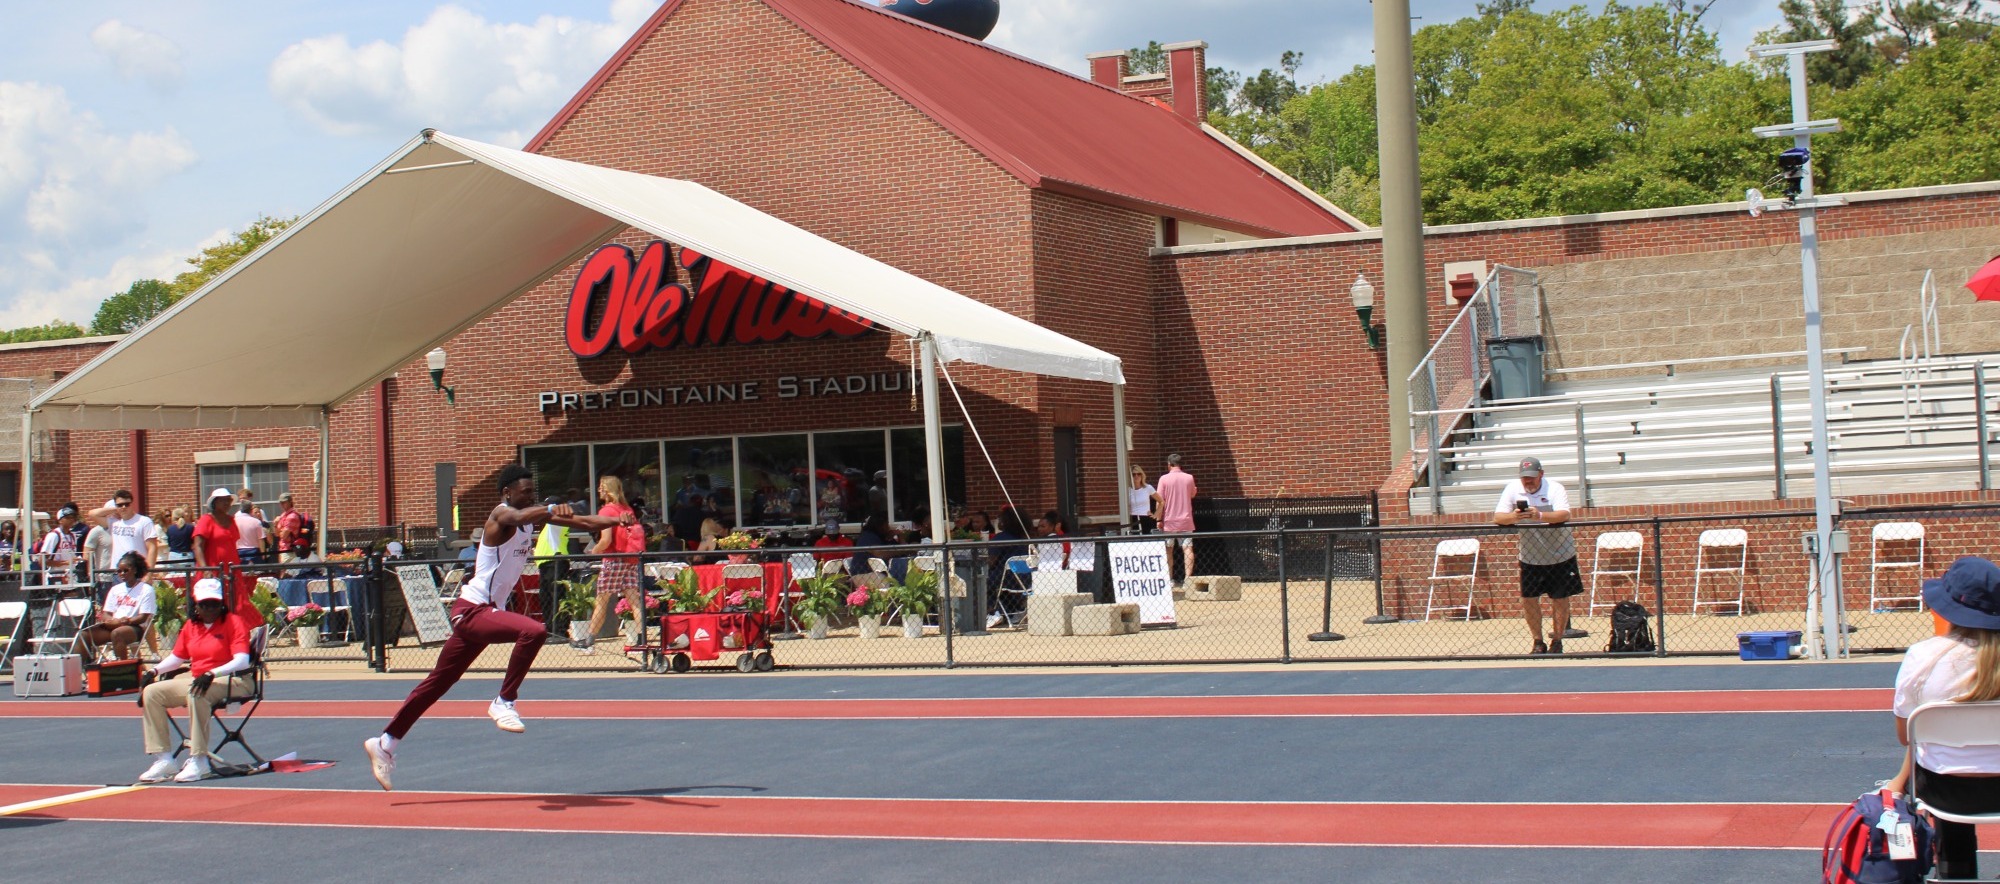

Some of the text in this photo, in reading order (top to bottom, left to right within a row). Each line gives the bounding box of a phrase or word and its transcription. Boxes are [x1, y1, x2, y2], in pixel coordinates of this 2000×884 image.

[565, 240, 690, 359] Ole
[538, 381, 760, 412] PREFONTAINE
[1115, 555, 1163, 574] PACKET
[1118, 578, 1166, 598] PICKUP
[25, 671, 49, 682] GILL
